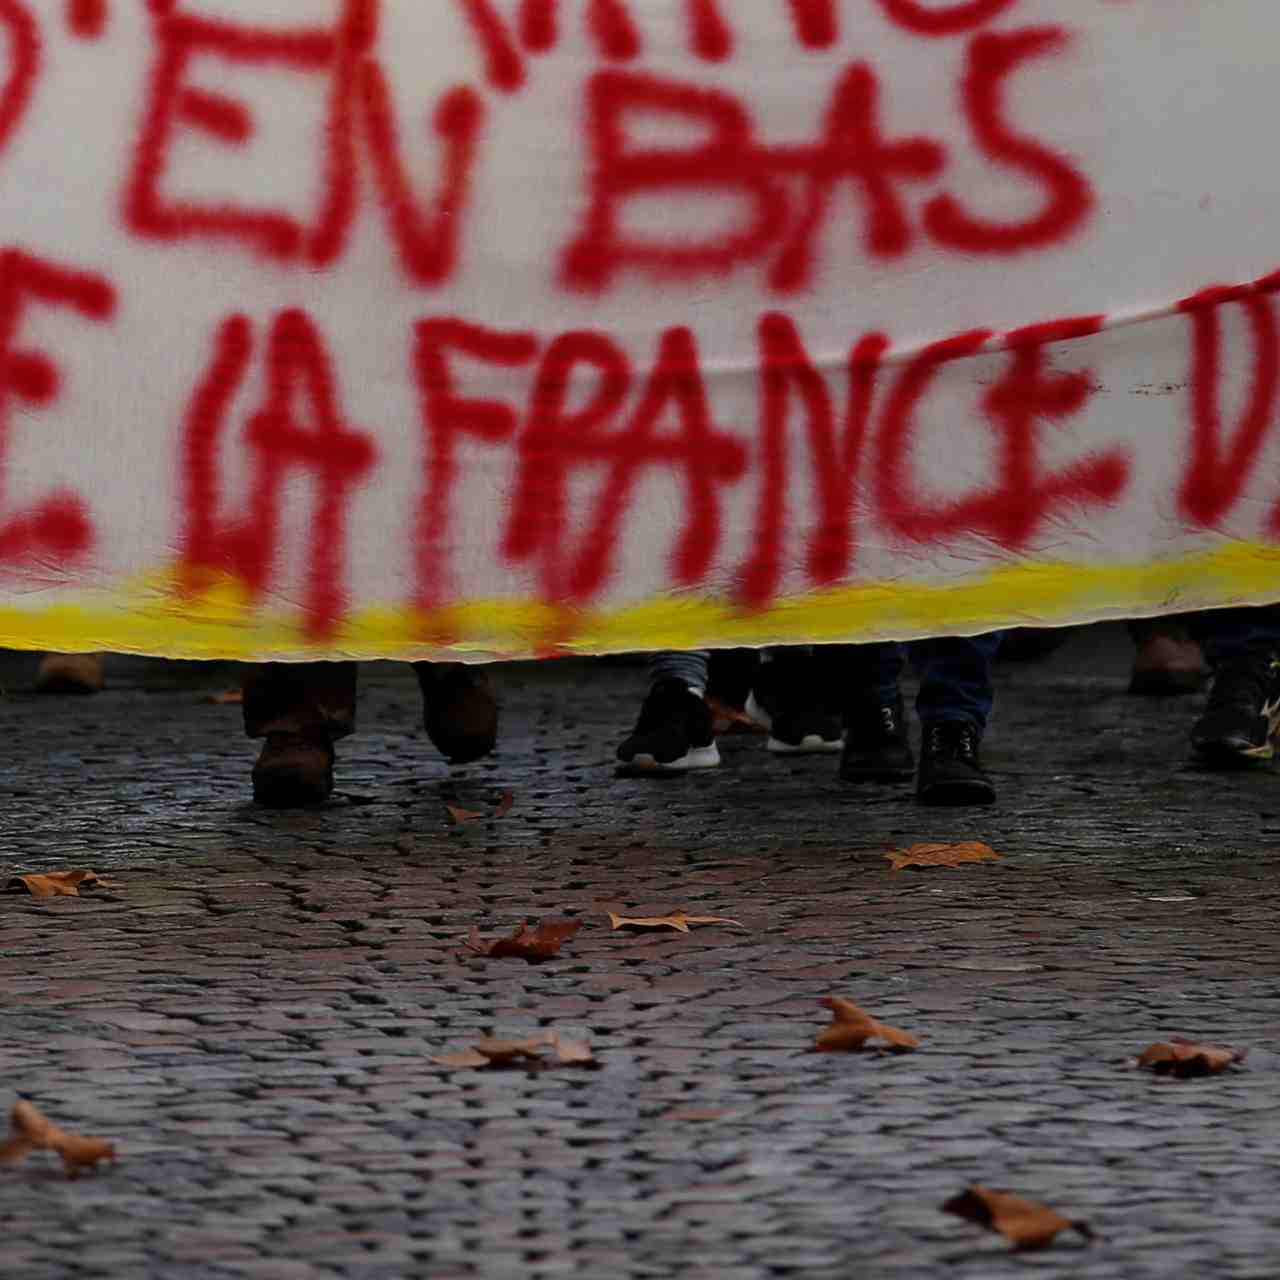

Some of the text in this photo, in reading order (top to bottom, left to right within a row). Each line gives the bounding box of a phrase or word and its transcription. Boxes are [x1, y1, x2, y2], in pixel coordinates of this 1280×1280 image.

[556, 24, 1096, 298] BAS
[177, 305, 380, 636] LA
[408, 308, 1130, 642] FRANCE
